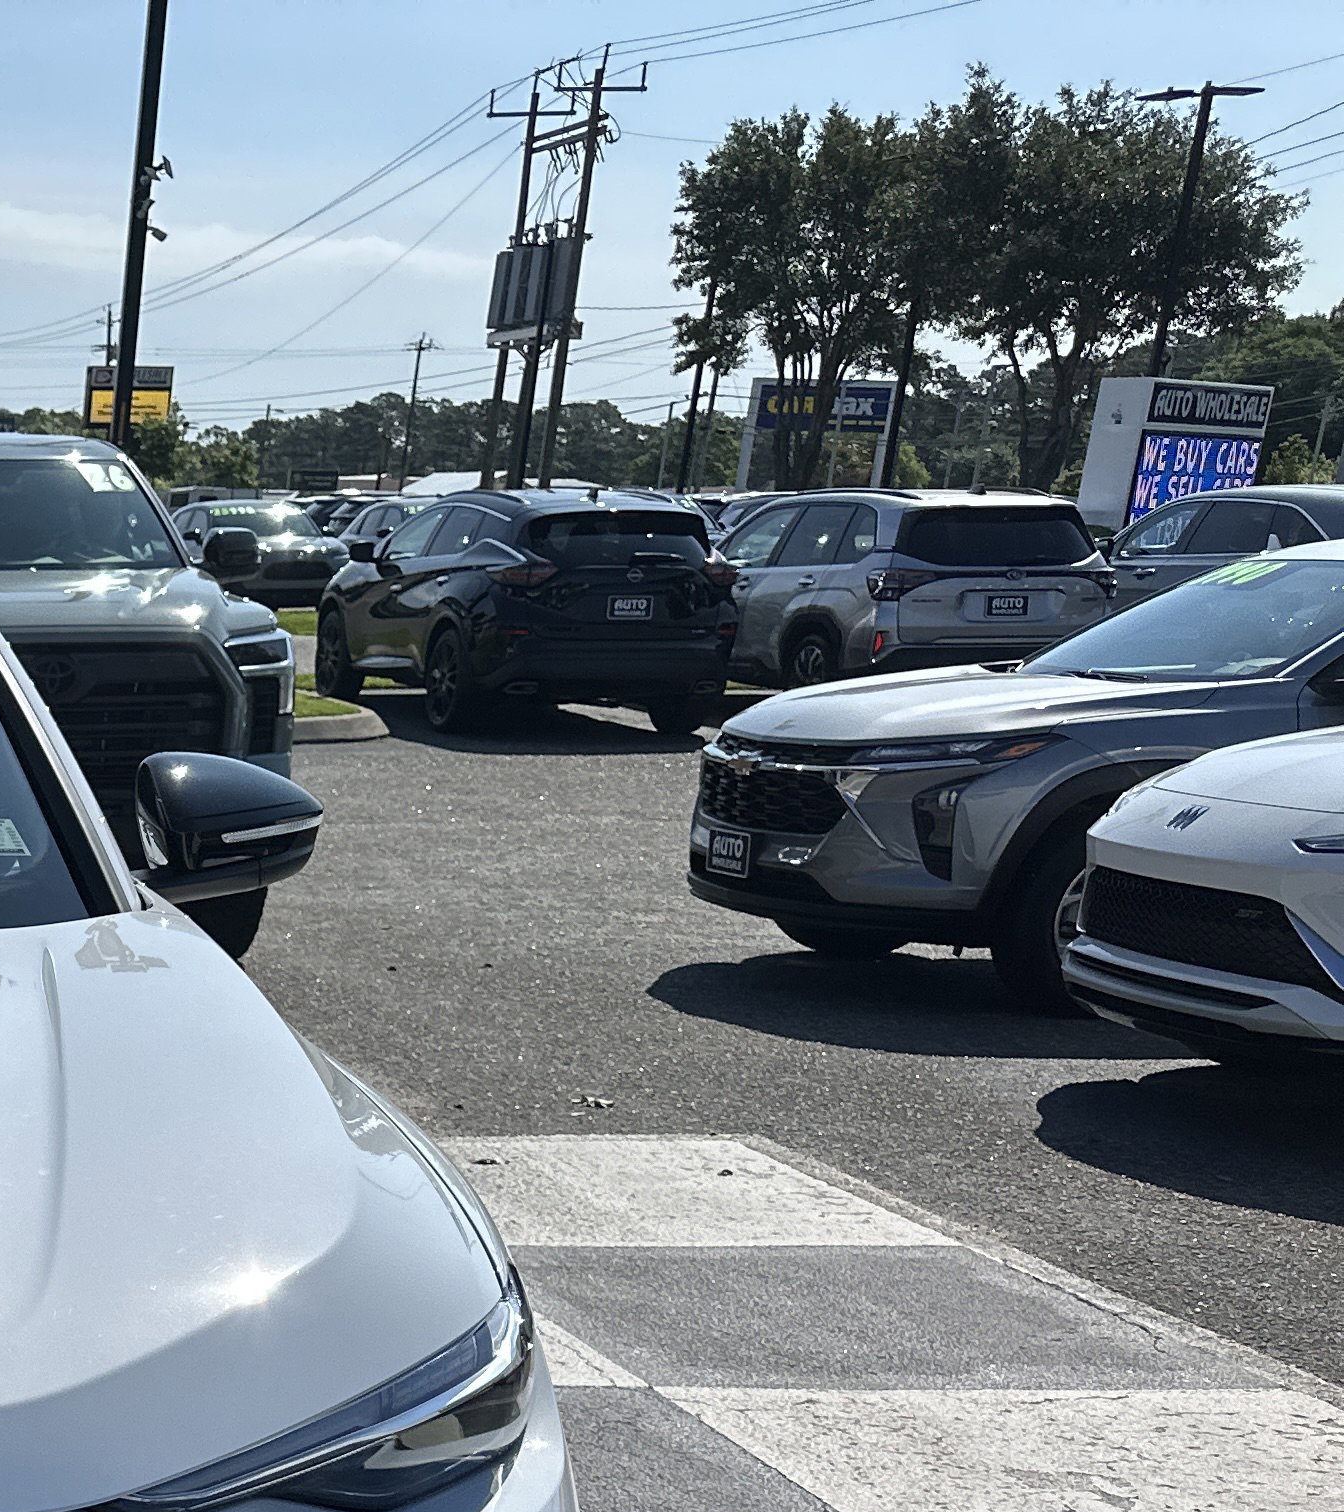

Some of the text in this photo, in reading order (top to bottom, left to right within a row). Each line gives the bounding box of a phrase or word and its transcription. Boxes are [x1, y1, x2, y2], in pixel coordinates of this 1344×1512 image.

[1154, 389, 1269, 423] AUTO WHOLESALE
[1142, 437, 1261, 475] WE BUY CARS
[1134, 474, 1161, 509] WE
[614, 600, 647, 610] AUTO
[992, 598, 1024, 608] AUTO
[713, 836, 743, 858] AUTO
